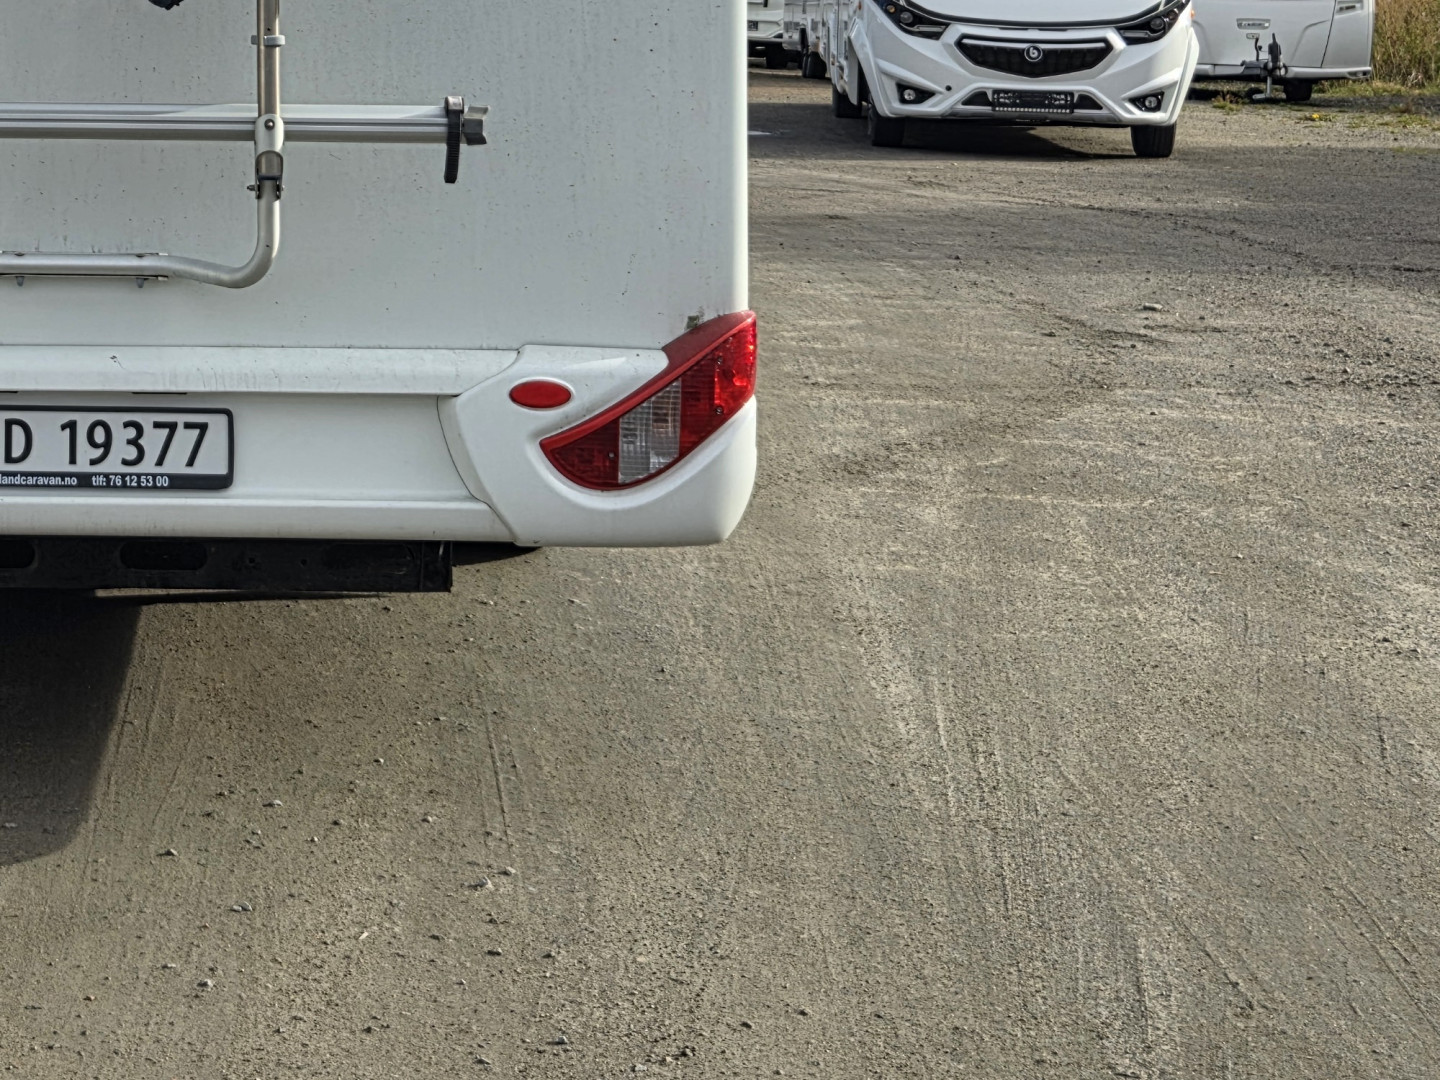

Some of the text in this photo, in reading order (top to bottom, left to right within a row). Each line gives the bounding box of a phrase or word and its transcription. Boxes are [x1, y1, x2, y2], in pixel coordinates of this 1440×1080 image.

[60, 419, 209, 467] 19377
[92, 475, 107, 486] tlf:
[109, 475, 122, 486] 76
[125, 475, 138, 486] 12
[140, 475, 153, 486] 53
[155, 476, 169, 487] 00
